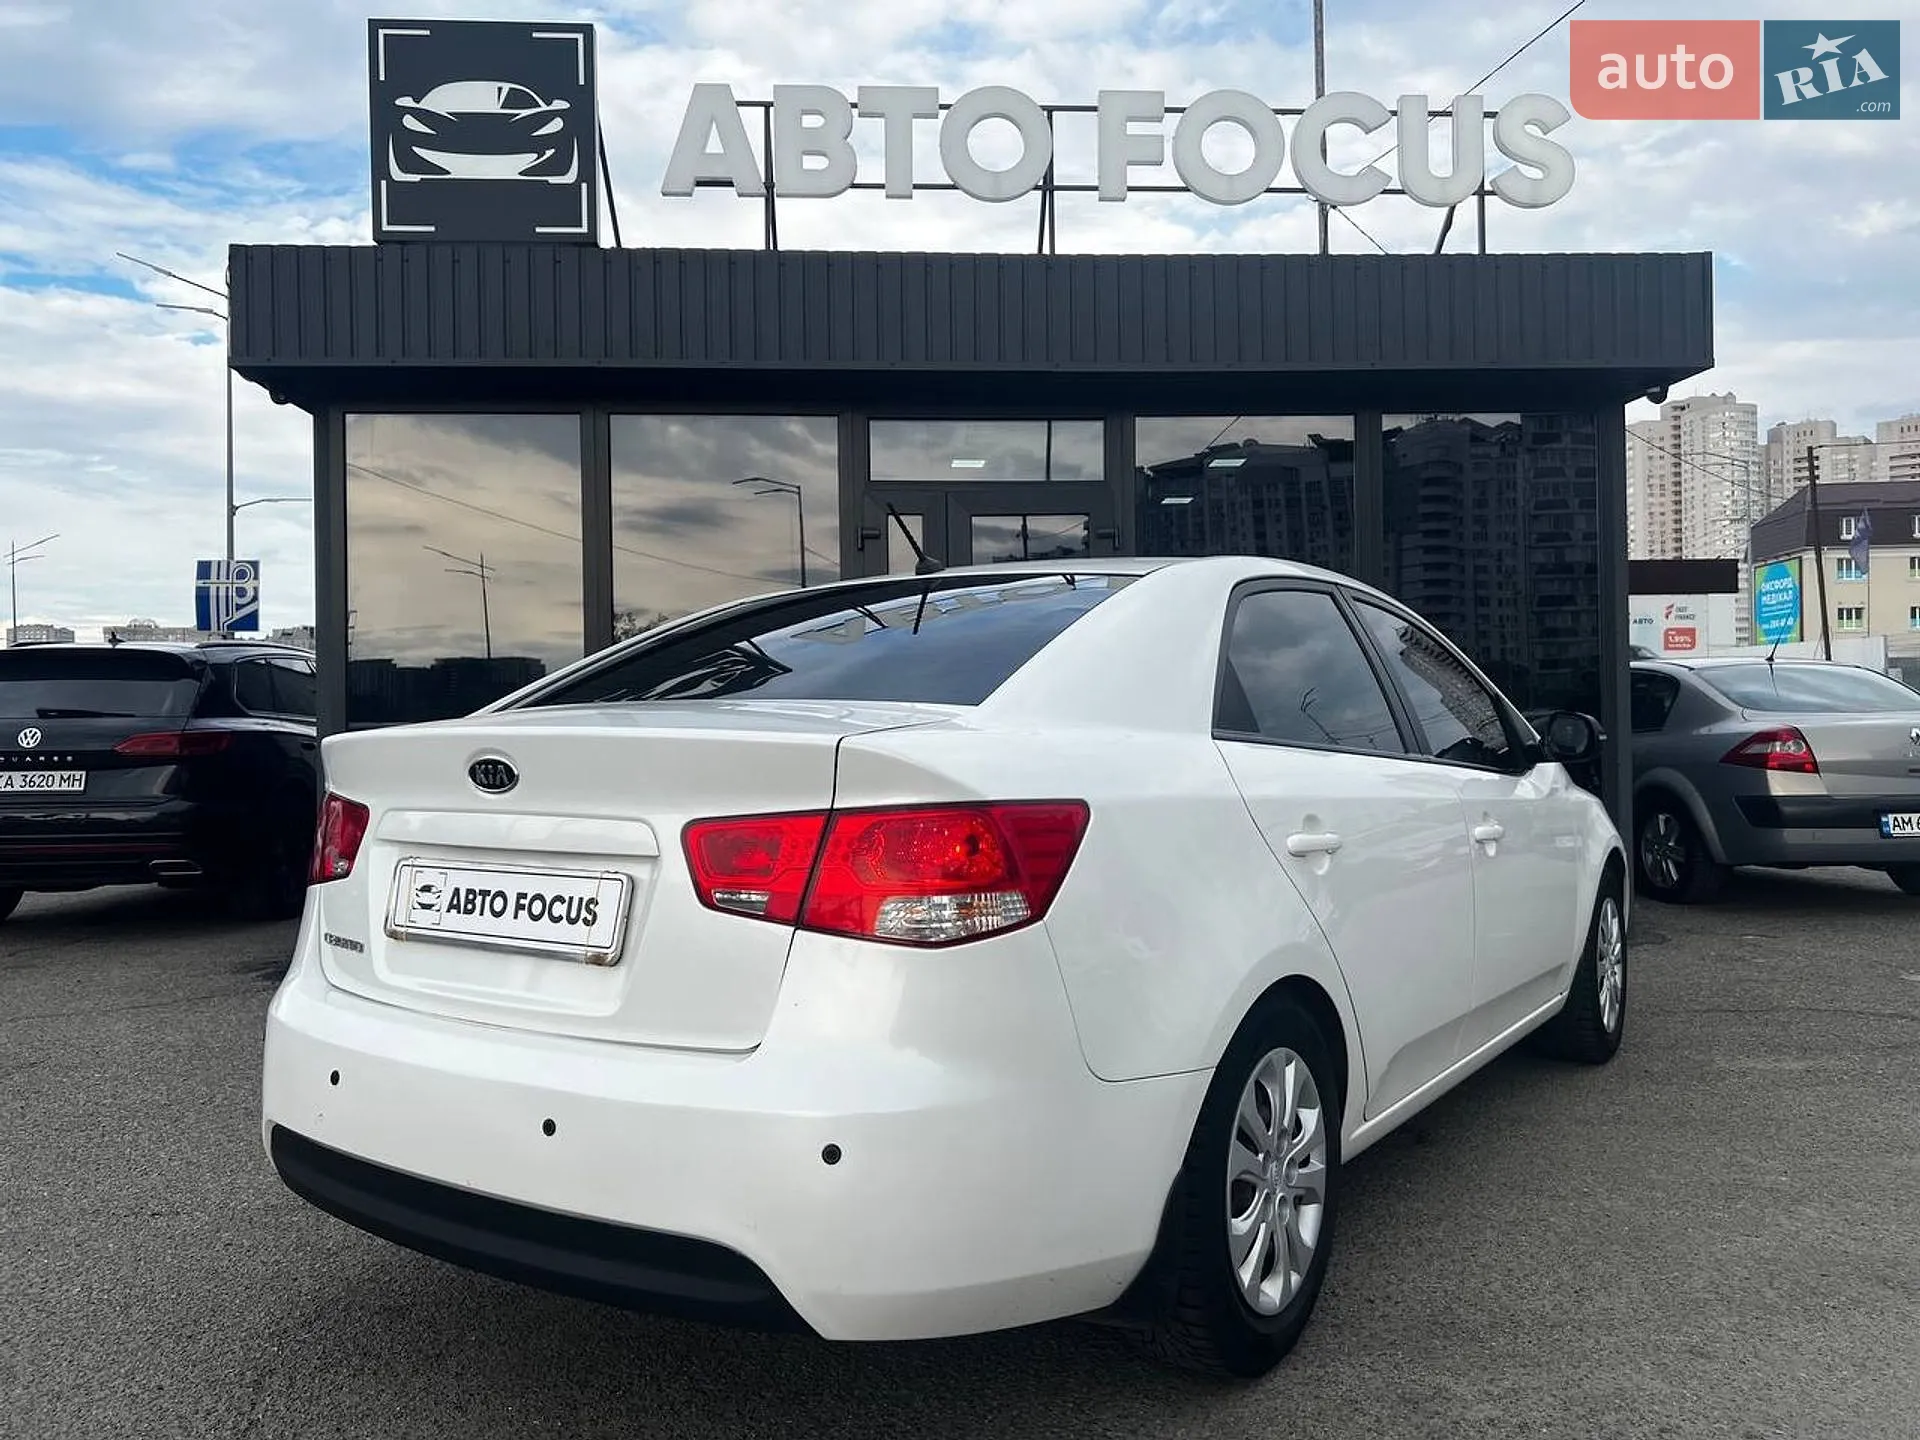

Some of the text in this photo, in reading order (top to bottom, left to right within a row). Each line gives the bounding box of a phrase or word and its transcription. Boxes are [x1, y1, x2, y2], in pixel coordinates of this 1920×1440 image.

[661, 83, 1577, 209] АВТО FOCUS
[19, 774, 55, 788] 3620
[59, 773, 83, 788] MH
[1892, 816, 1914, 831] AM
[446, 887, 600, 927] АВТО FOCUS
